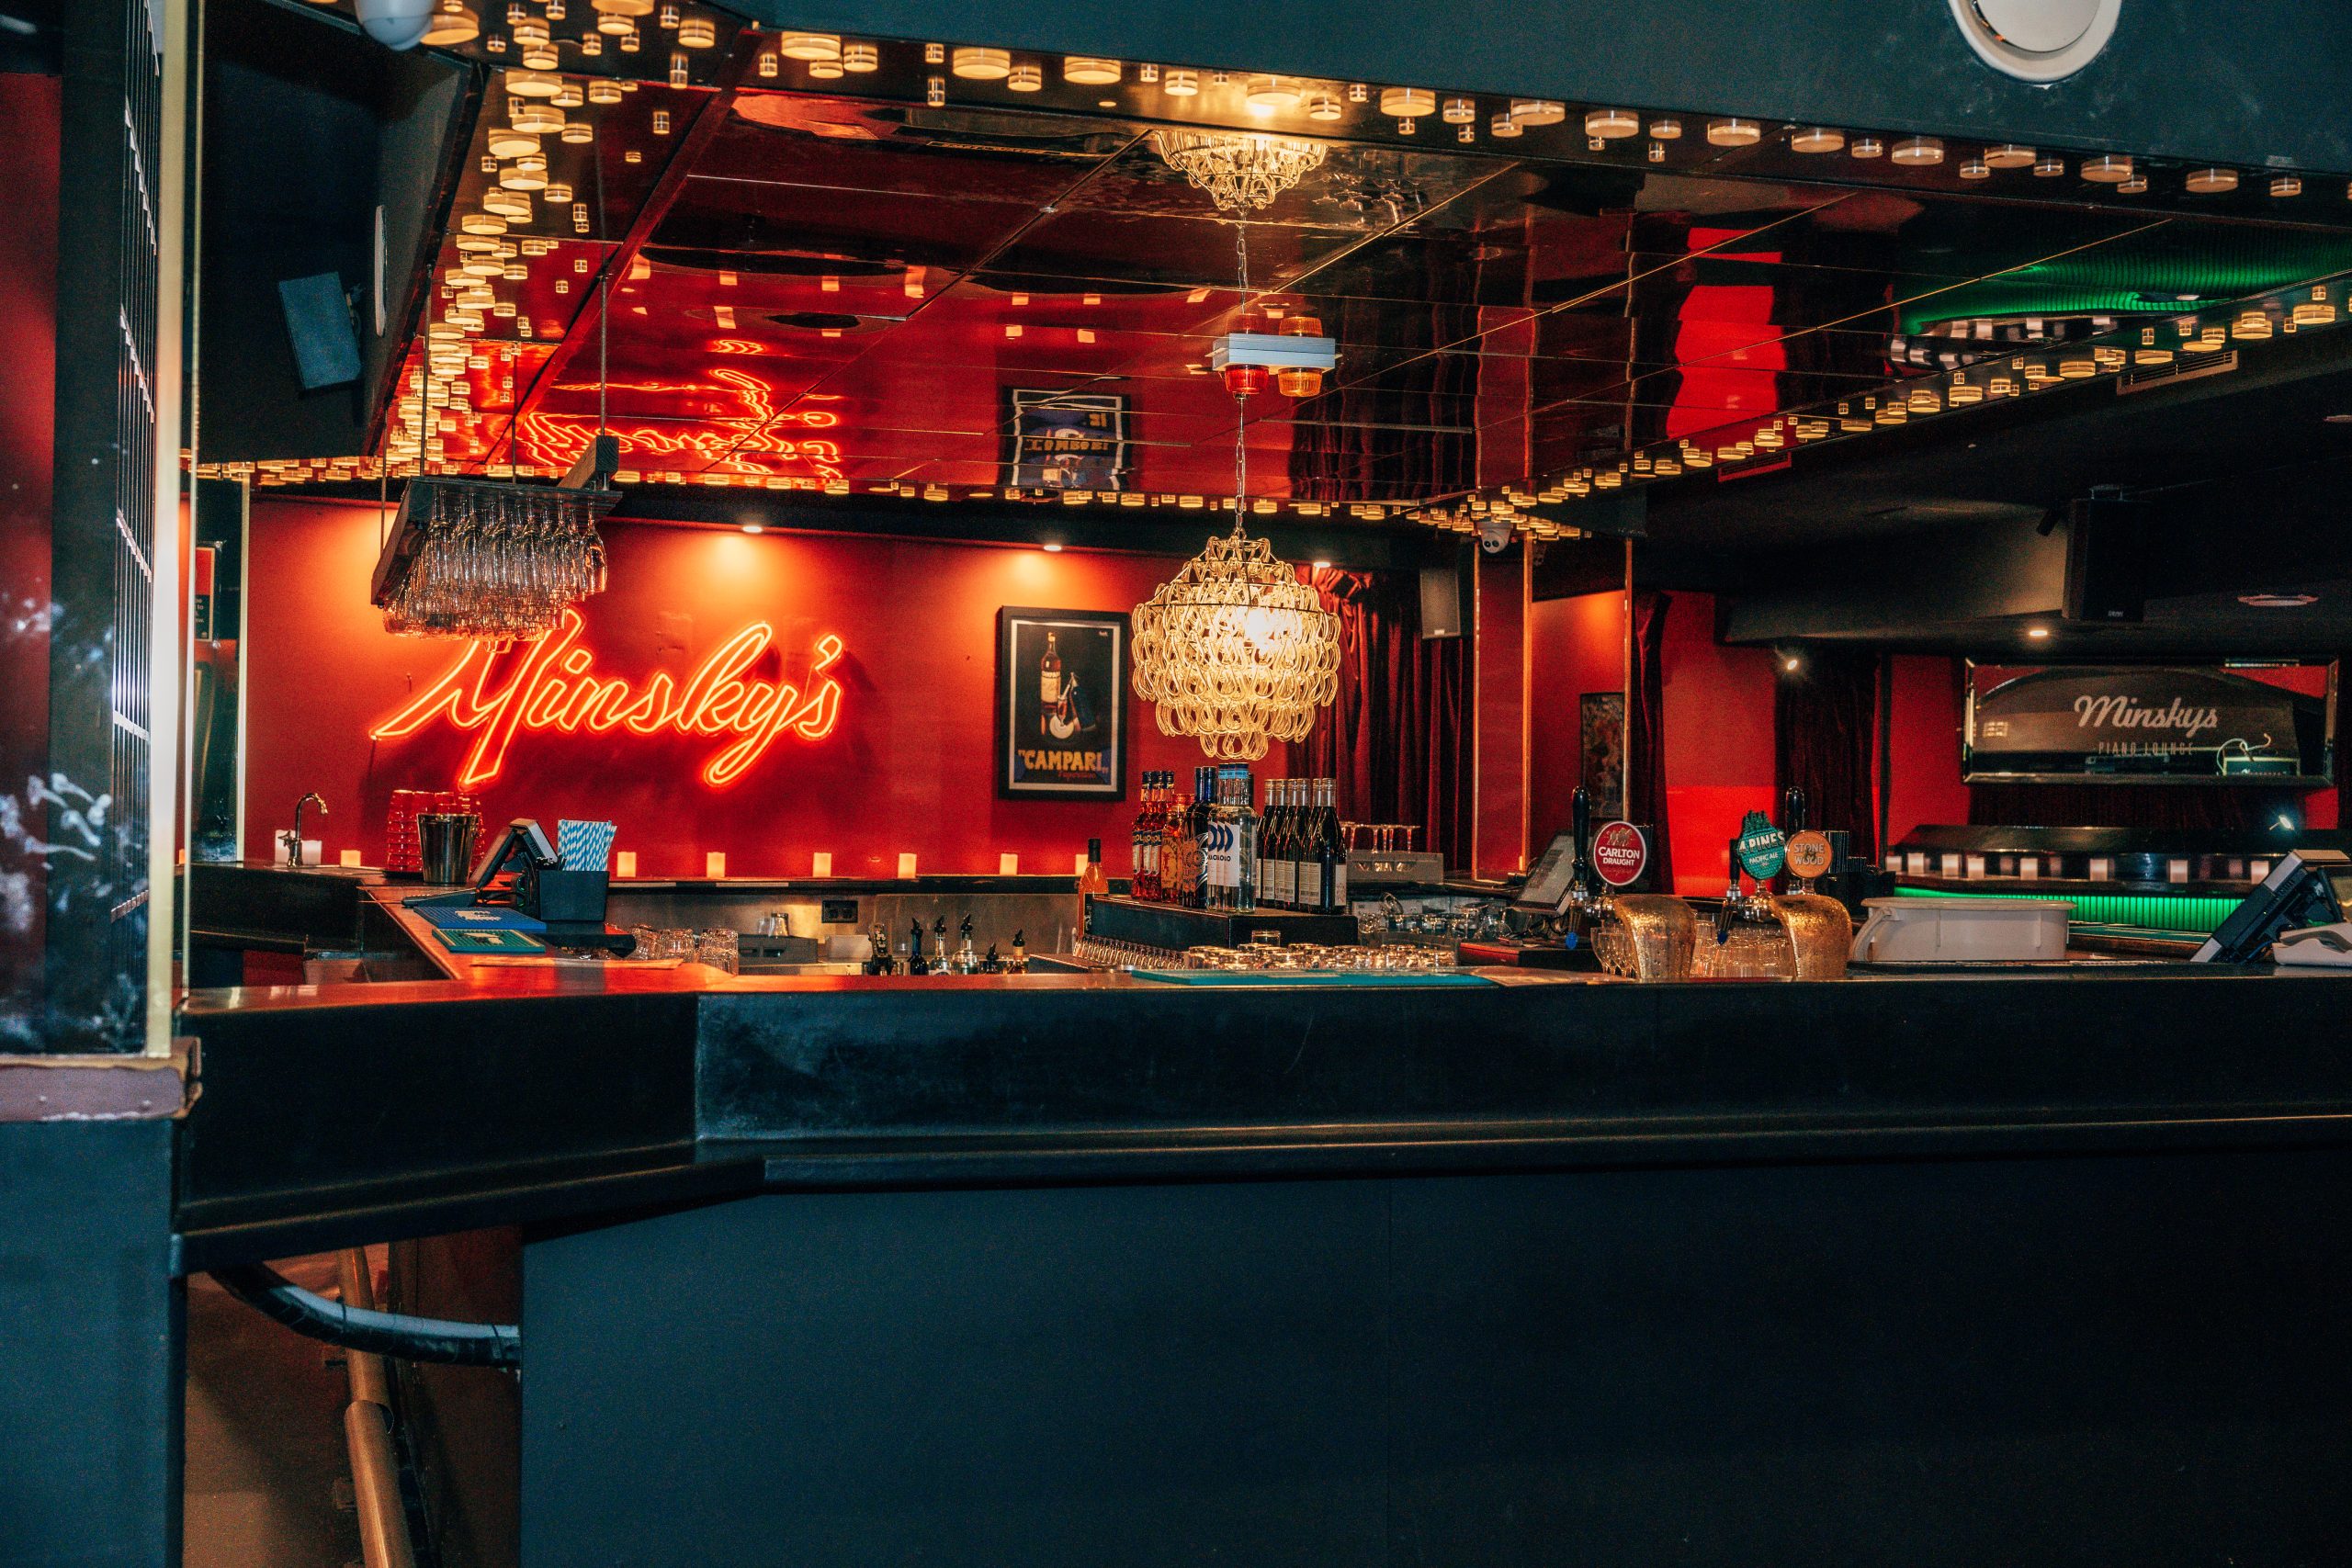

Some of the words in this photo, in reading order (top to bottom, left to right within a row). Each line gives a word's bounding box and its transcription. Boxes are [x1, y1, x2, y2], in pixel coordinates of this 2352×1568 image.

[369, 608, 844, 787] Minsky's
[2074, 695, 2219, 739] Minskys
[2098, 741, 2137, 756] PIANO
[2145, 741, 2194, 756] LOUNGE
[1738, 840, 1747, 853] 4
[1748, 830, 1785, 851] PINES
[1793, 843, 1825, 853] STONE
[1599, 846, 1640, 860] CARLTON
[1794, 855, 1825, 865] WOOD
[1602, 857, 1635, 866] DRAUGHT
